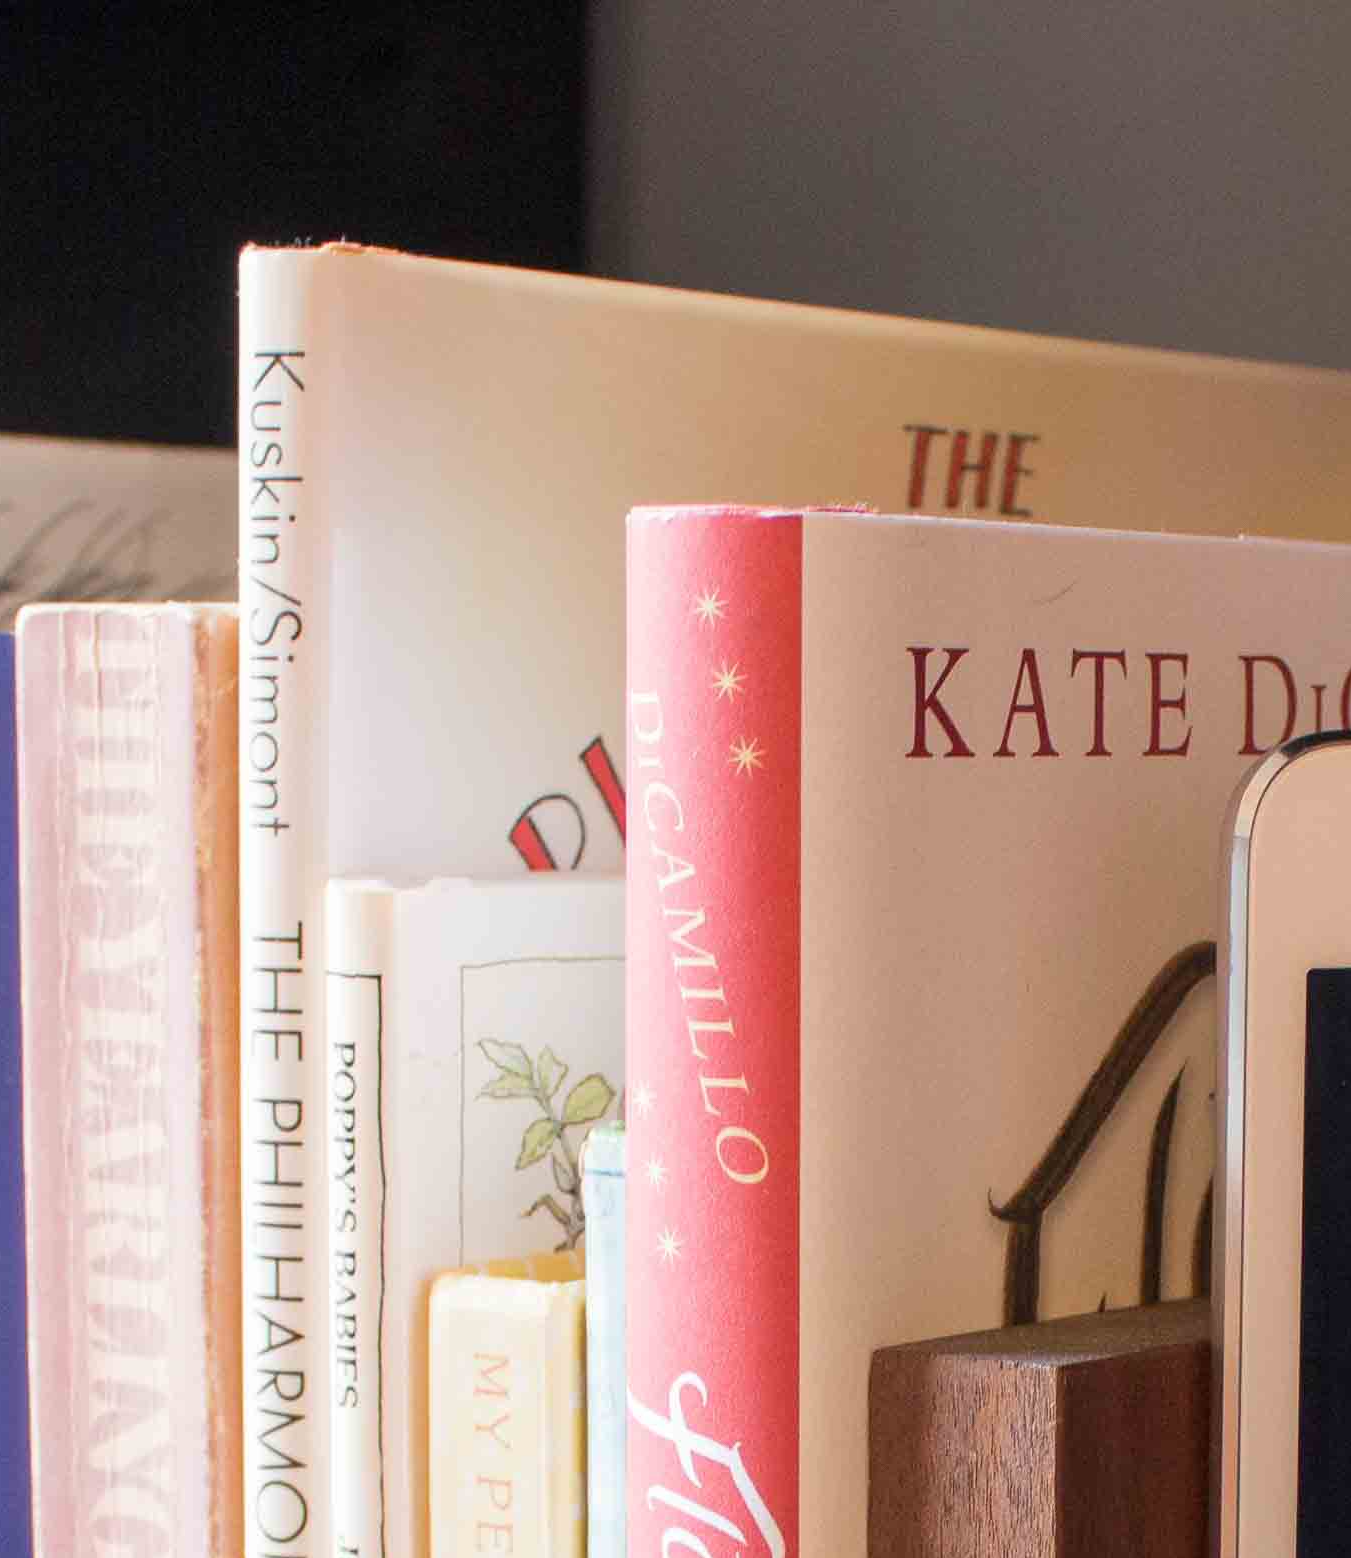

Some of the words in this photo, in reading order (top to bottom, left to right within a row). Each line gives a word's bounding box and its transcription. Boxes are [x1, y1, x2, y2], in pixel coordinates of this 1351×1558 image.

[903, 424, 1040, 517] THE
[250, 350, 306, 837] Kuskin/Simont
[75, 637, 165, 884] THE
[905, 646, 1193, 758] KATE
[252, 920, 306, 1062] THE
[333, 1040, 359, 1233] POPPY'S
[335, 1249, 360, 1409] BABIES
[471, 1350, 513, 1451] MY
